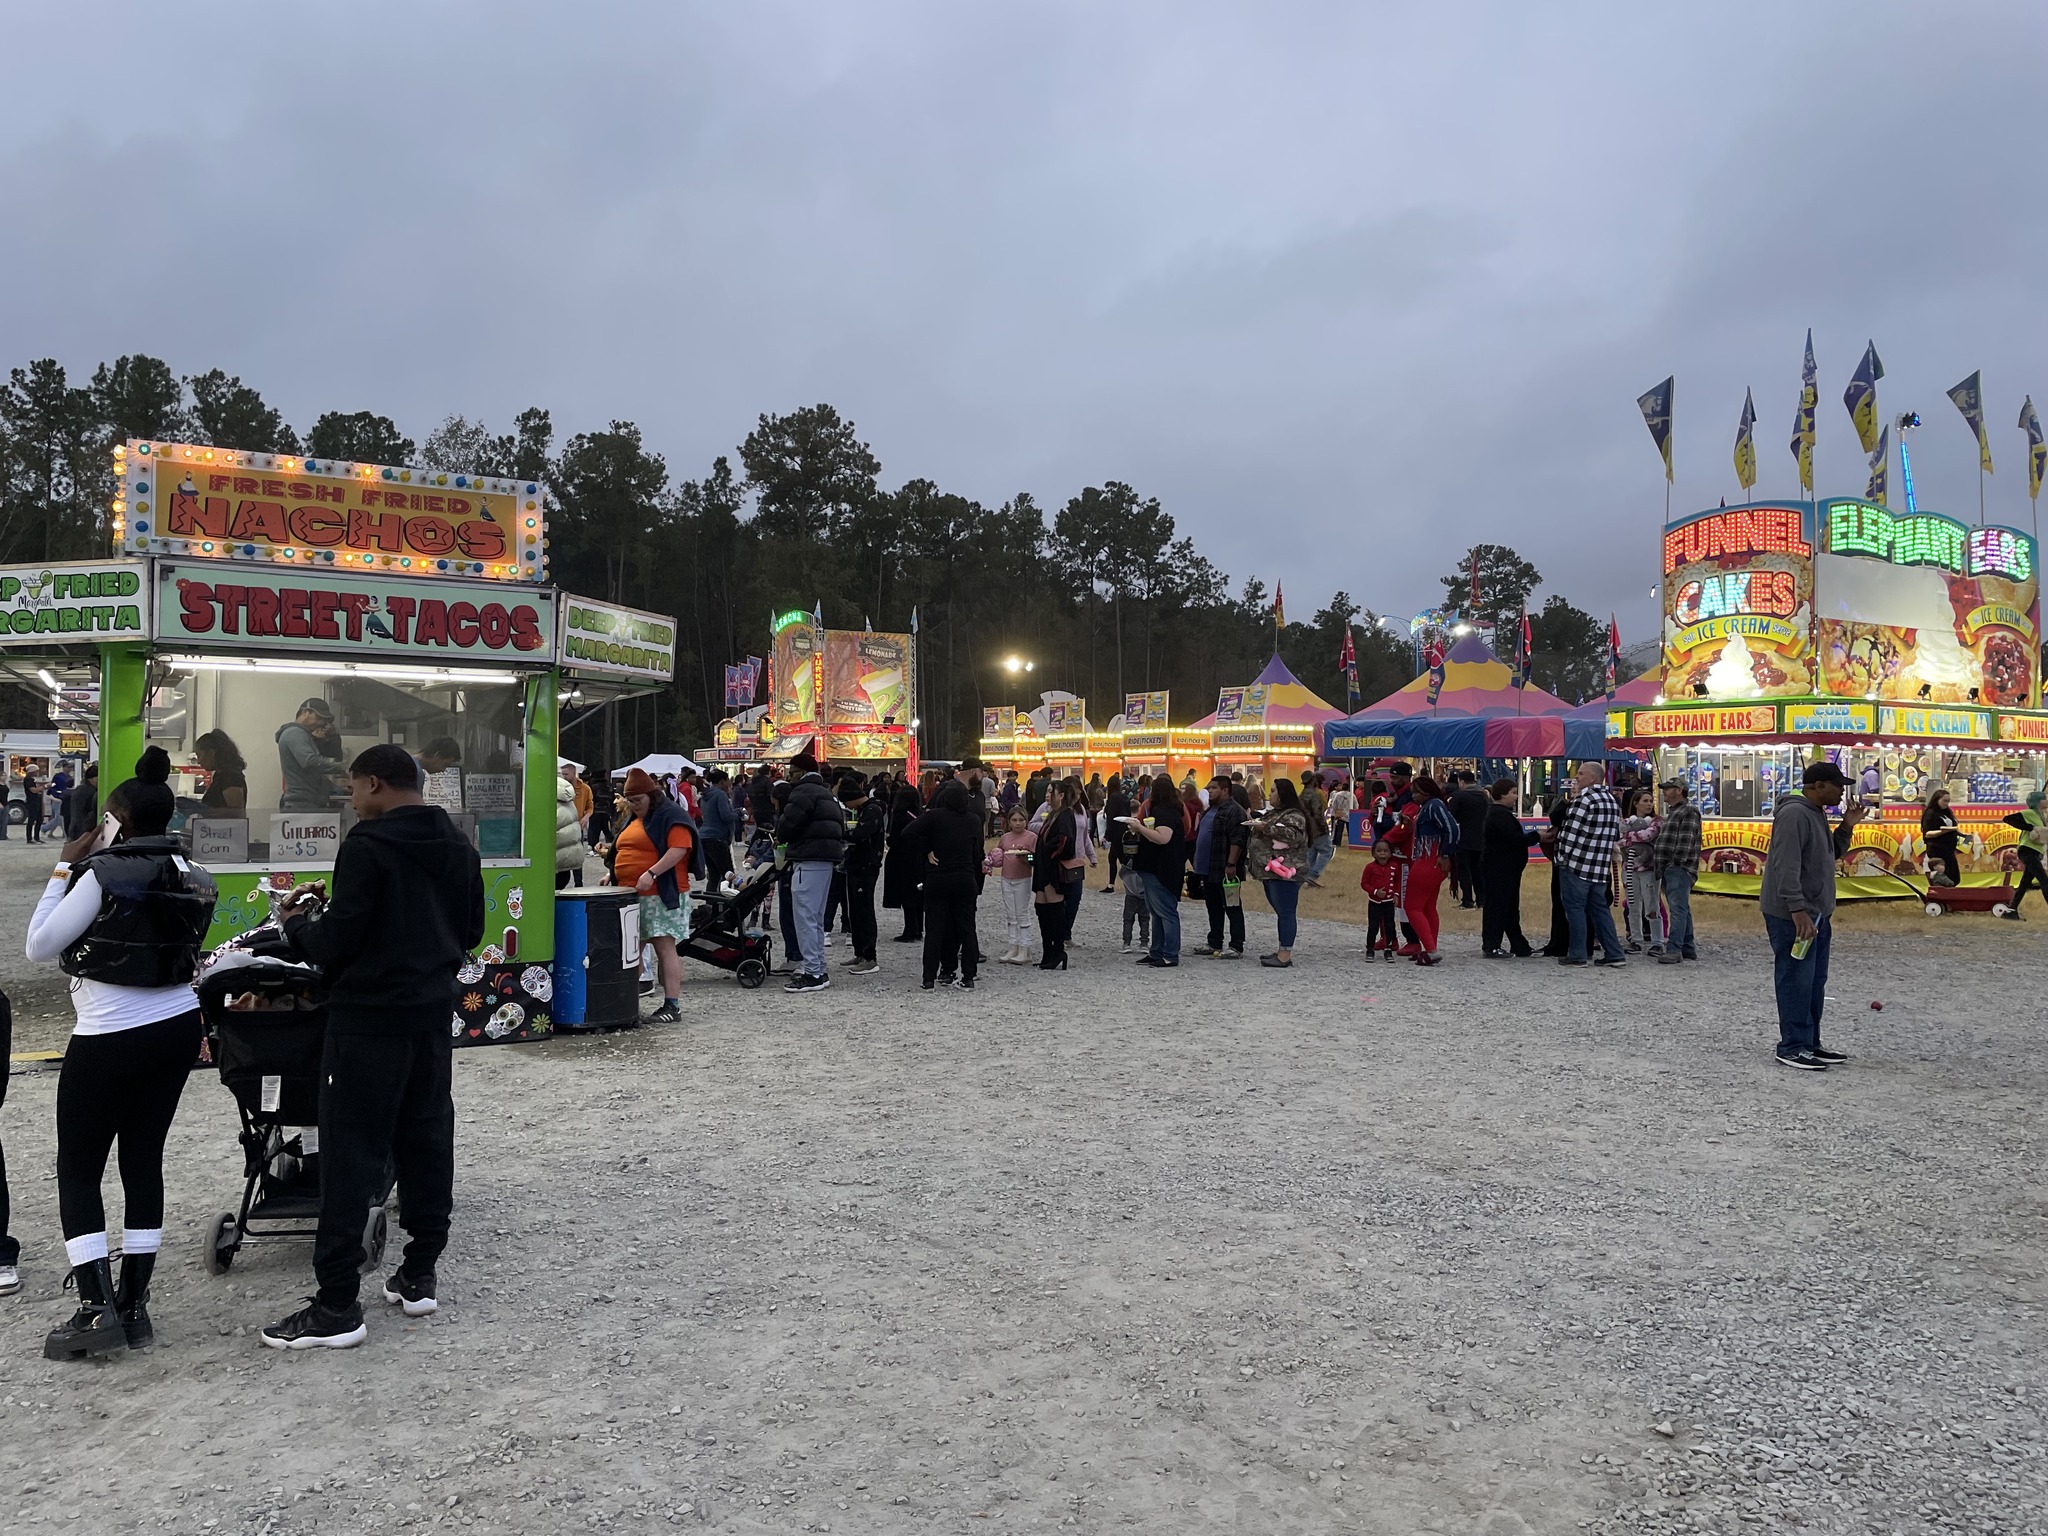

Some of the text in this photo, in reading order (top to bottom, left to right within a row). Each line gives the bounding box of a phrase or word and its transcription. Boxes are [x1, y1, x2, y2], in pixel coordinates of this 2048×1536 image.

[208, 474, 472, 515] FRESH FRIED
[168, 493, 507, 559] NACHOS
[1665, 508, 1811, 575] FUNNEL
[1830, 503, 2031, 582] ELEPHANT EARS
[54, 571, 140, 599] FRIED
[1676, 571, 1796, 626] CAKES
[180, 582, 542, 651] STREET TACOS
[568, 605, 617, 635] DEEP
[631, 619, 673, 646] FRIED
[1981, 607, 1993, 624] ICE
[1995, 607, 2021, 627] CREAM
[1697, 622, 1717, 641] ICE
[1723, 617, 1771, 635] CREAM
[1773, 622, 1791, 637] Serve
[565, 635, 671, 673] MARGARITA
[1654, 711, 1752, 732] ELEPHANT EARS
[1813, 706, 1850, 716] COLD
[1793, 715, 1866, 731] DRINKS
[1906, 711, 1925, 732] ICE
[1929, 712, 1970, 734] CREAM
[1234, 735, 1259, 743] TICKETS
[1332, 736, 1395, 748] GUEST SERVICES
[200, 826, 232, 839] Street
[1701, 832, 1744, 848] EPHANT
[1870, 832, 1893, 851] CAKES
[201, 843, 230, 854] Corn
[277, 844, 285, 856] 3
[295, 841, 317, 856] $5
